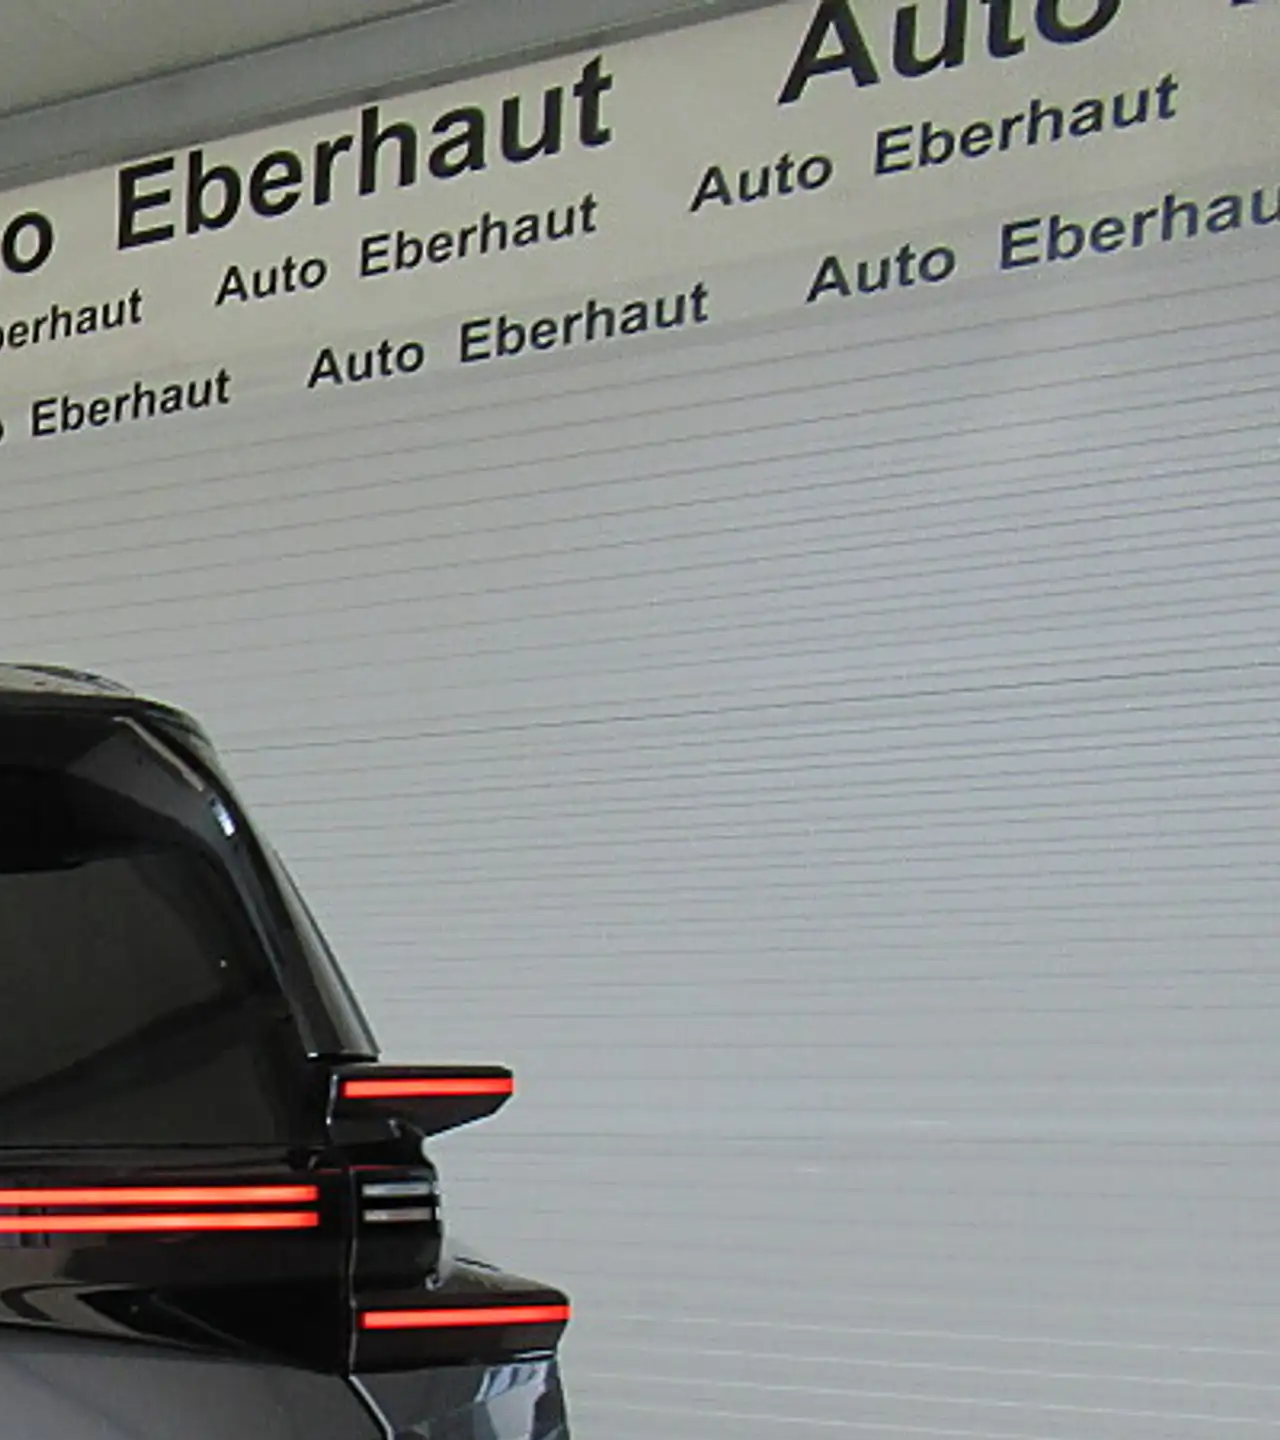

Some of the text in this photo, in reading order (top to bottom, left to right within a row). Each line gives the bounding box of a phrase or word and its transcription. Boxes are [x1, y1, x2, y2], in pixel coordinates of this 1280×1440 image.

[777, 0, 1122, 105] Auto
[117, 55, 614, 251] Eberhaut
[689, 74, 1178, 212] Auto Eberhaut
[214, 194, 598, 306] Auto Eberhaut
[806, 244, 956, 303] Auto
[307, 282, 709, 389] Auto Eberhaut
[32, 369, 231, 437] Eberhaut
